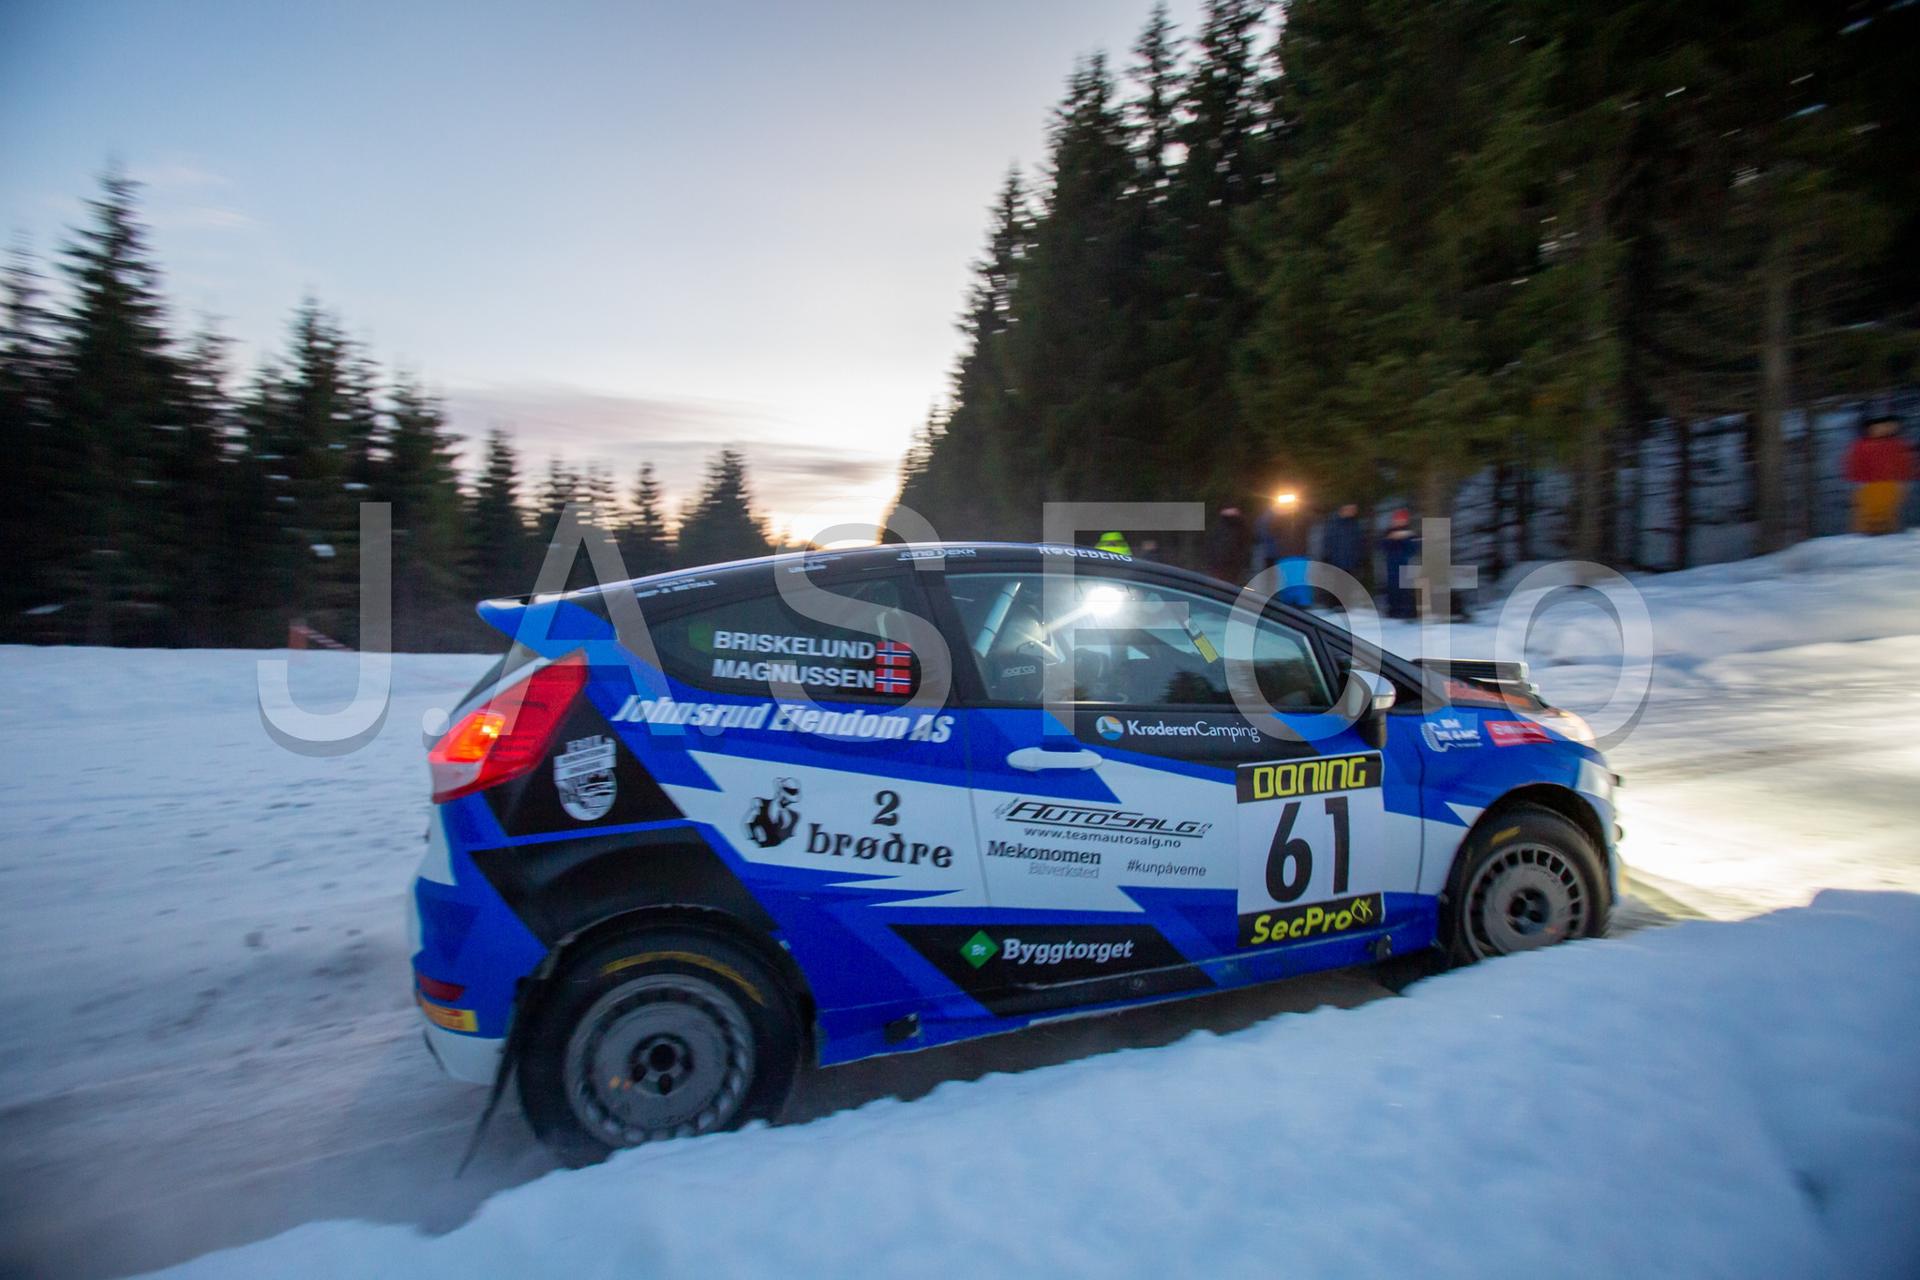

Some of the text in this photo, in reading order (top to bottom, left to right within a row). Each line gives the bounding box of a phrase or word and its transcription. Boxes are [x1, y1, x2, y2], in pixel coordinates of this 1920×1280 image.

[713, 631, 876, 660] BRISKELUND
[712, 659, 876, 689] MAGNUSSEN
[611, 695, 955, 743] Johnsrud Eiendom AS
[1253, 757, 1367, 799] DONING
[872, 790, 901, 826] 2
[806, 822, 954, 868] brødre
[987, 839, 1101, 865] Mekonomen
[1024, 826, 1182, 849] www.teamautosalg.no
[1265, 796, 1349, 903] 61
[1250, 907, 1351, 945] SecPro
[1002, 937, 1134, 965] Byggtorget
